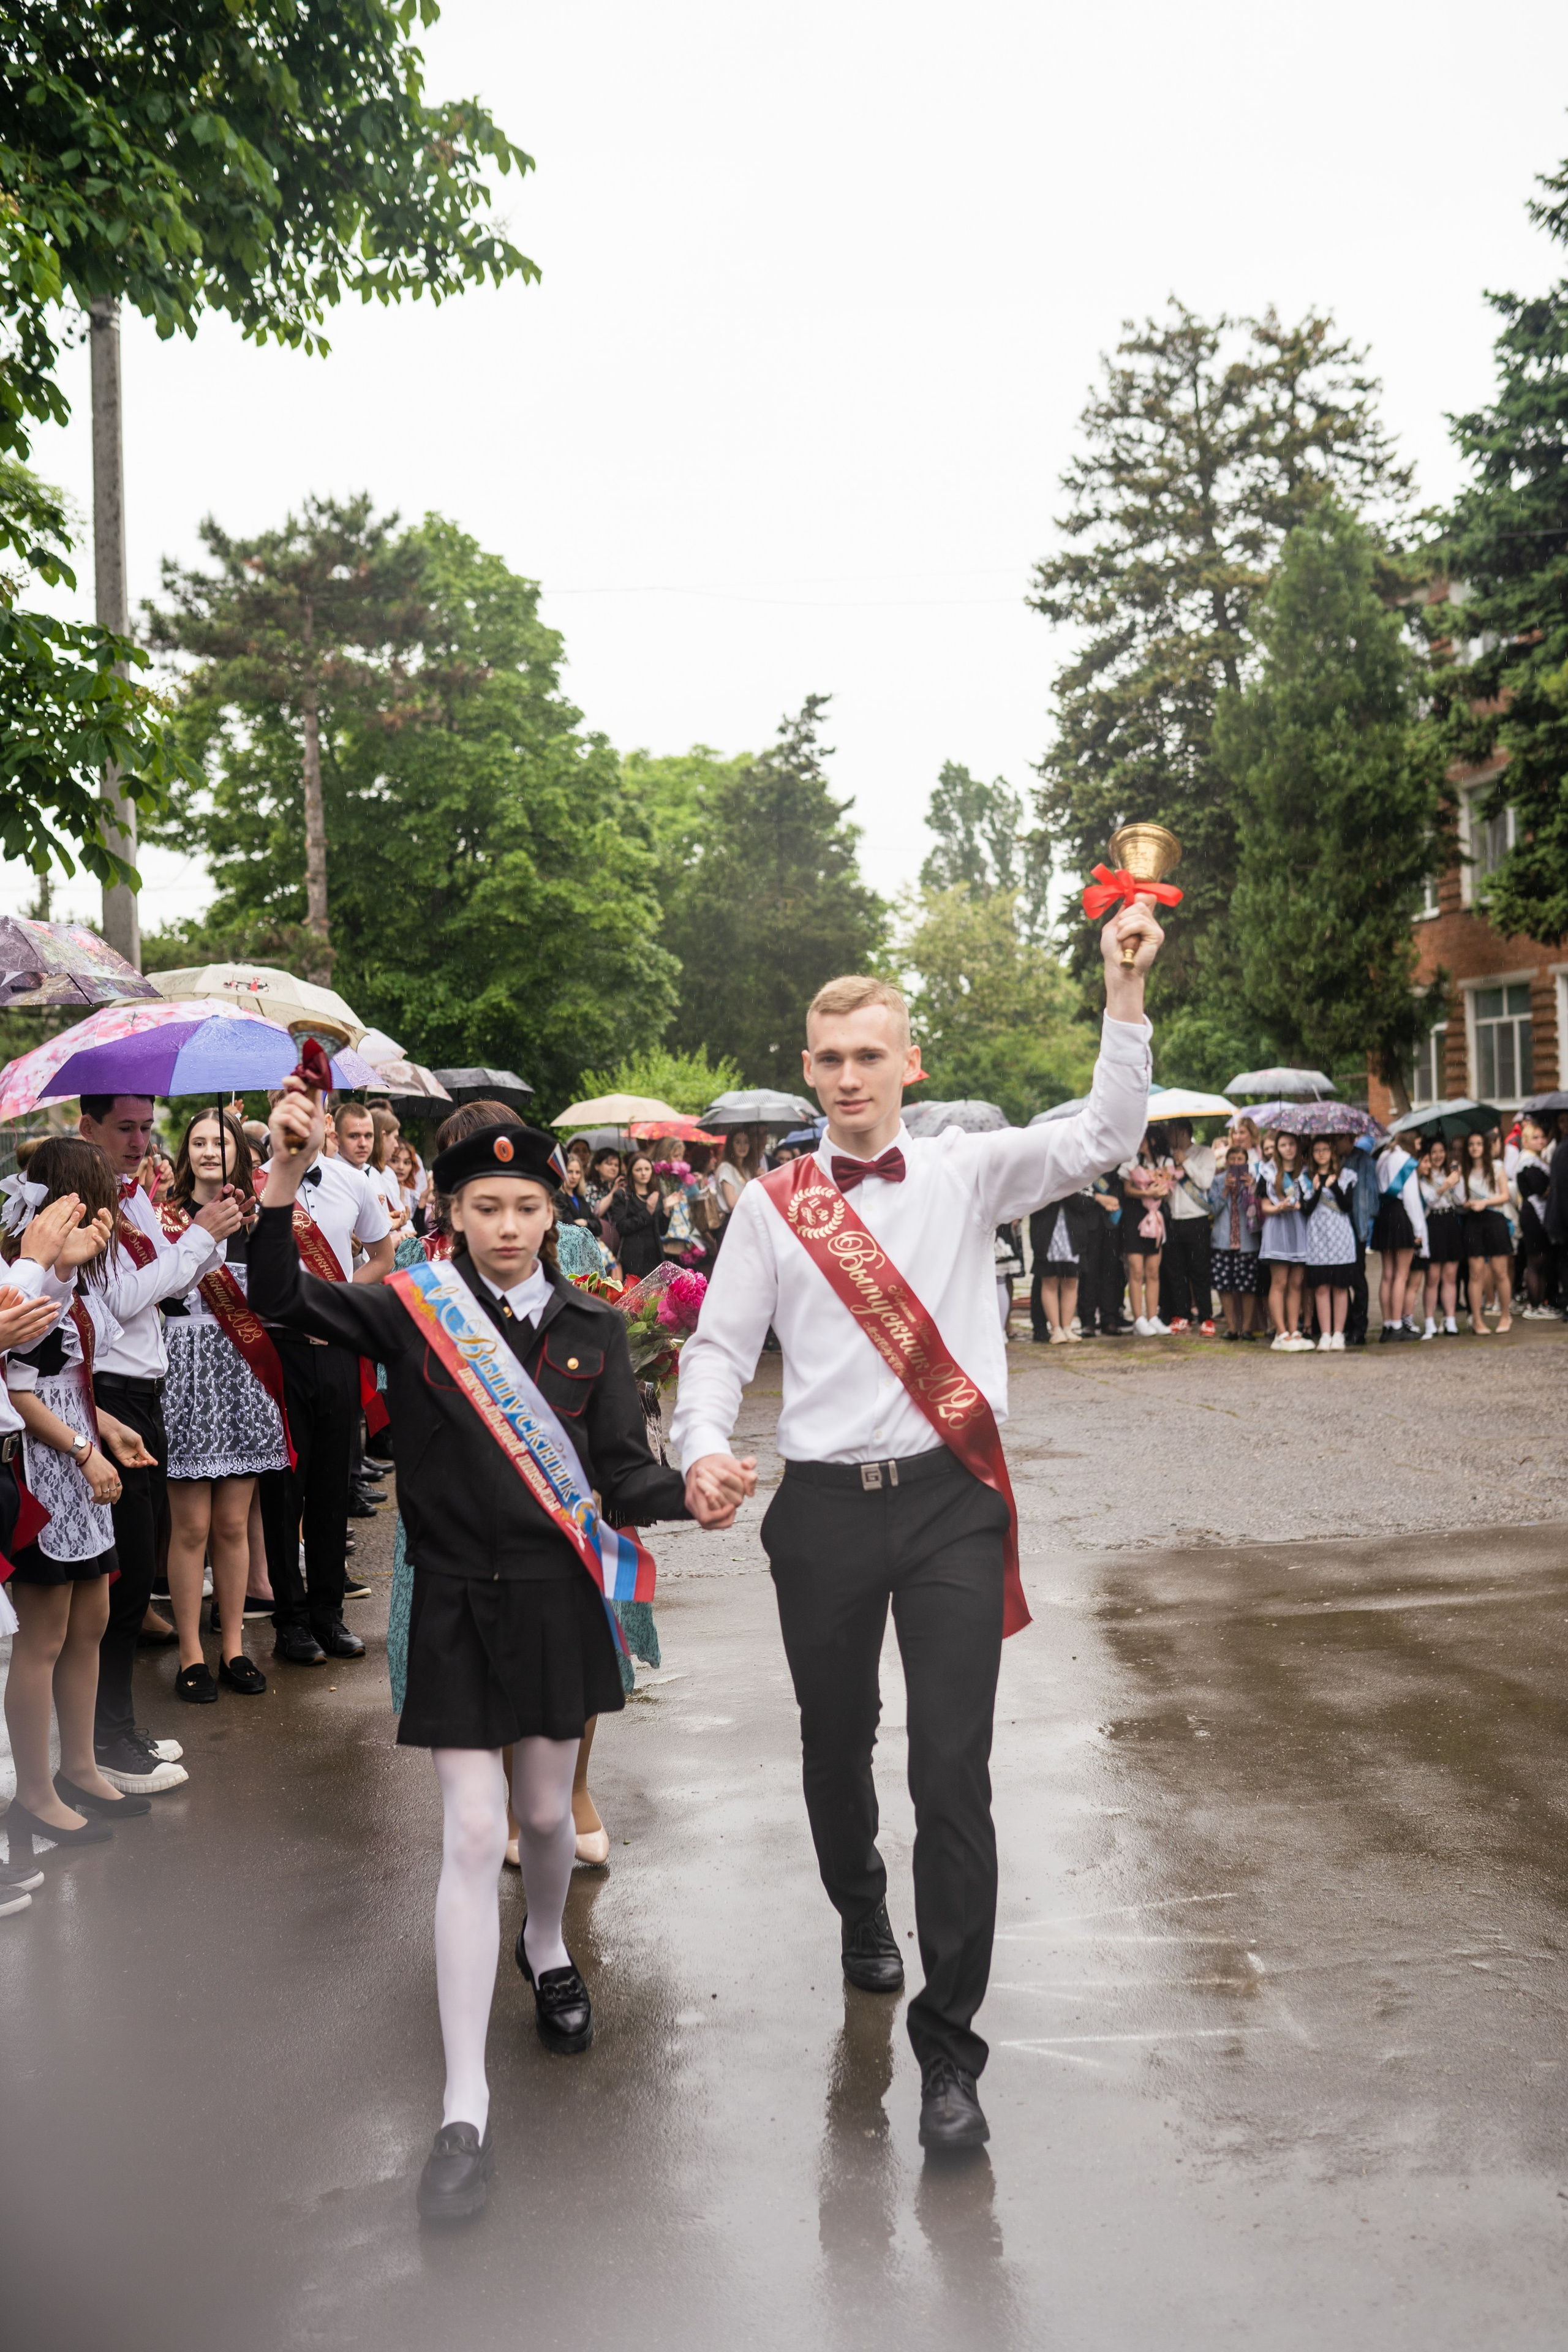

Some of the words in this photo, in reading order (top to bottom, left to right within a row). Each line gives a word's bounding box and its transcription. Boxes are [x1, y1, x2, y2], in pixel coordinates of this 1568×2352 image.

[227, 1309, 262, 1343] 2023
[441, 1302, 579, 1502] Выпускник
[827, 1231, 930, 1373] Выпускник
[919, 1362, 986, 1430] 2023
